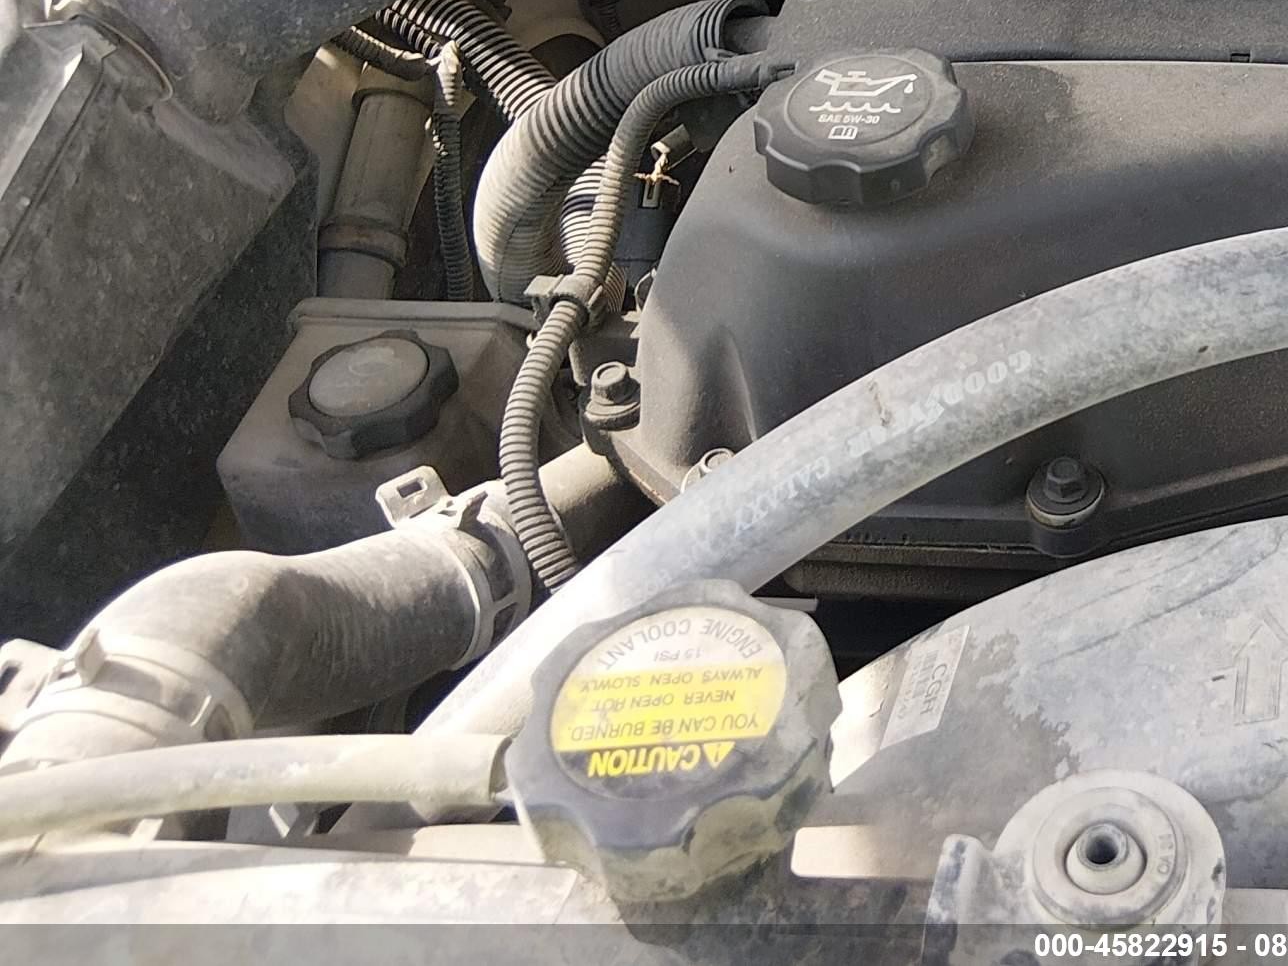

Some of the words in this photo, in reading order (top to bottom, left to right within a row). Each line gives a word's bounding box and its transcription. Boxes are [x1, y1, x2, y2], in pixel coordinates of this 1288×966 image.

[817, 113, 842, 123] SAE
[842, 114, 881, 124] 5W-30
[598, 619, 692, 670] COOLANT
[698, 619, 763, 659] ENGINE
[648, 671, 693, 686] OPEN
[702, 666, 763, 687] ALWAYS
[631, 692, 673, 708] OPEN
[683, 689, 736, 705] NEVER
[651, 717, 673, 735] BE
[678, 714, 716, 733] CAN
[720, 713, 759, 731] YOU
[587, 744, 701, 779] CAUTION
